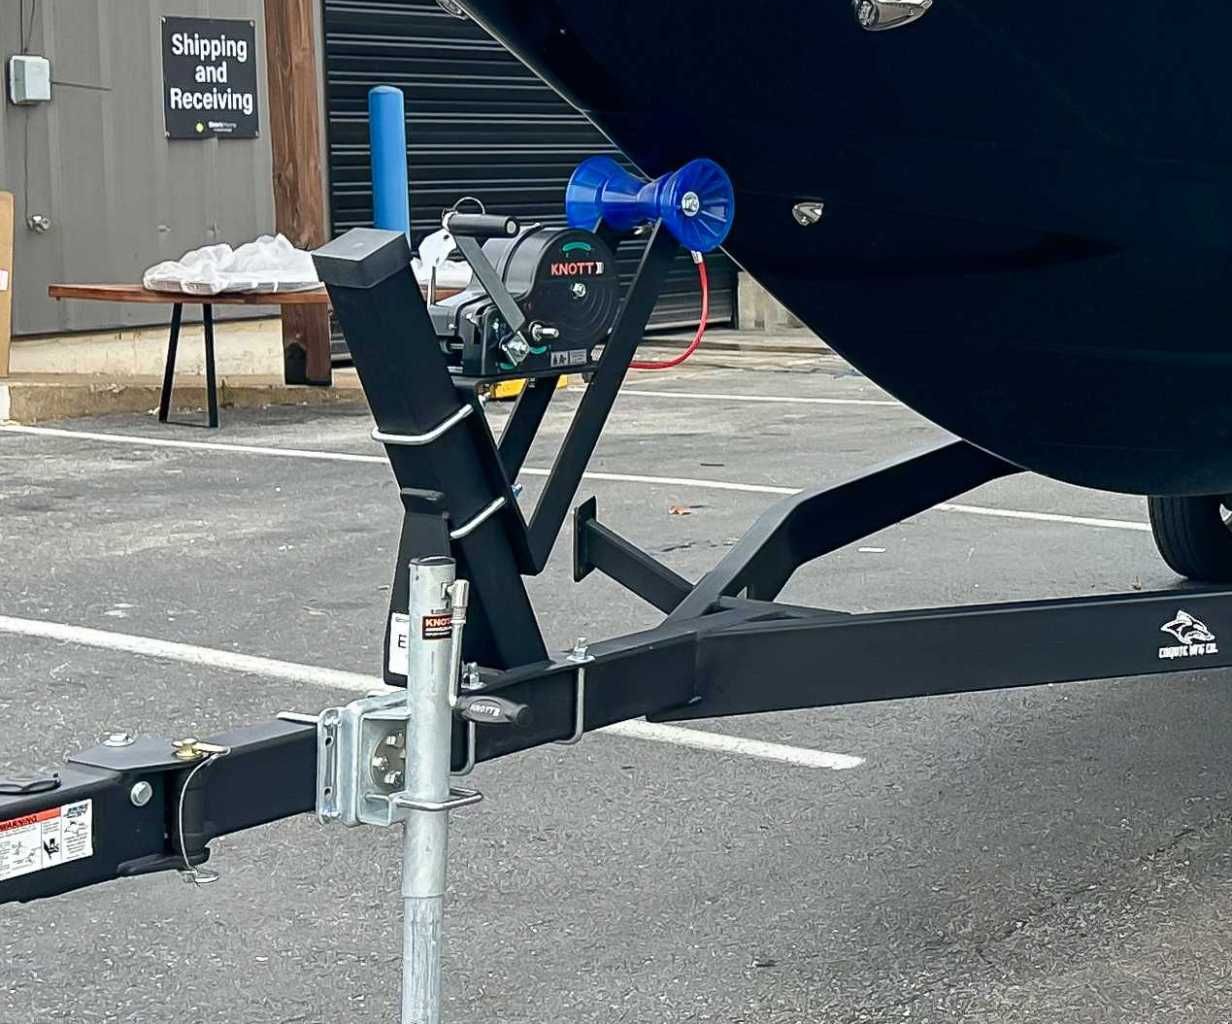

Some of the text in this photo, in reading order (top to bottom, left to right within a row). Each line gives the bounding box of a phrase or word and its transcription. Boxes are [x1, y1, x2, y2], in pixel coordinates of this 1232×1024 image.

[171, 33, 247, 62] Shipping
[195, 61, 227, 83] and
[170, 88, 253, 115] Receiving
[551, 262, 594, 275] KNOTT
